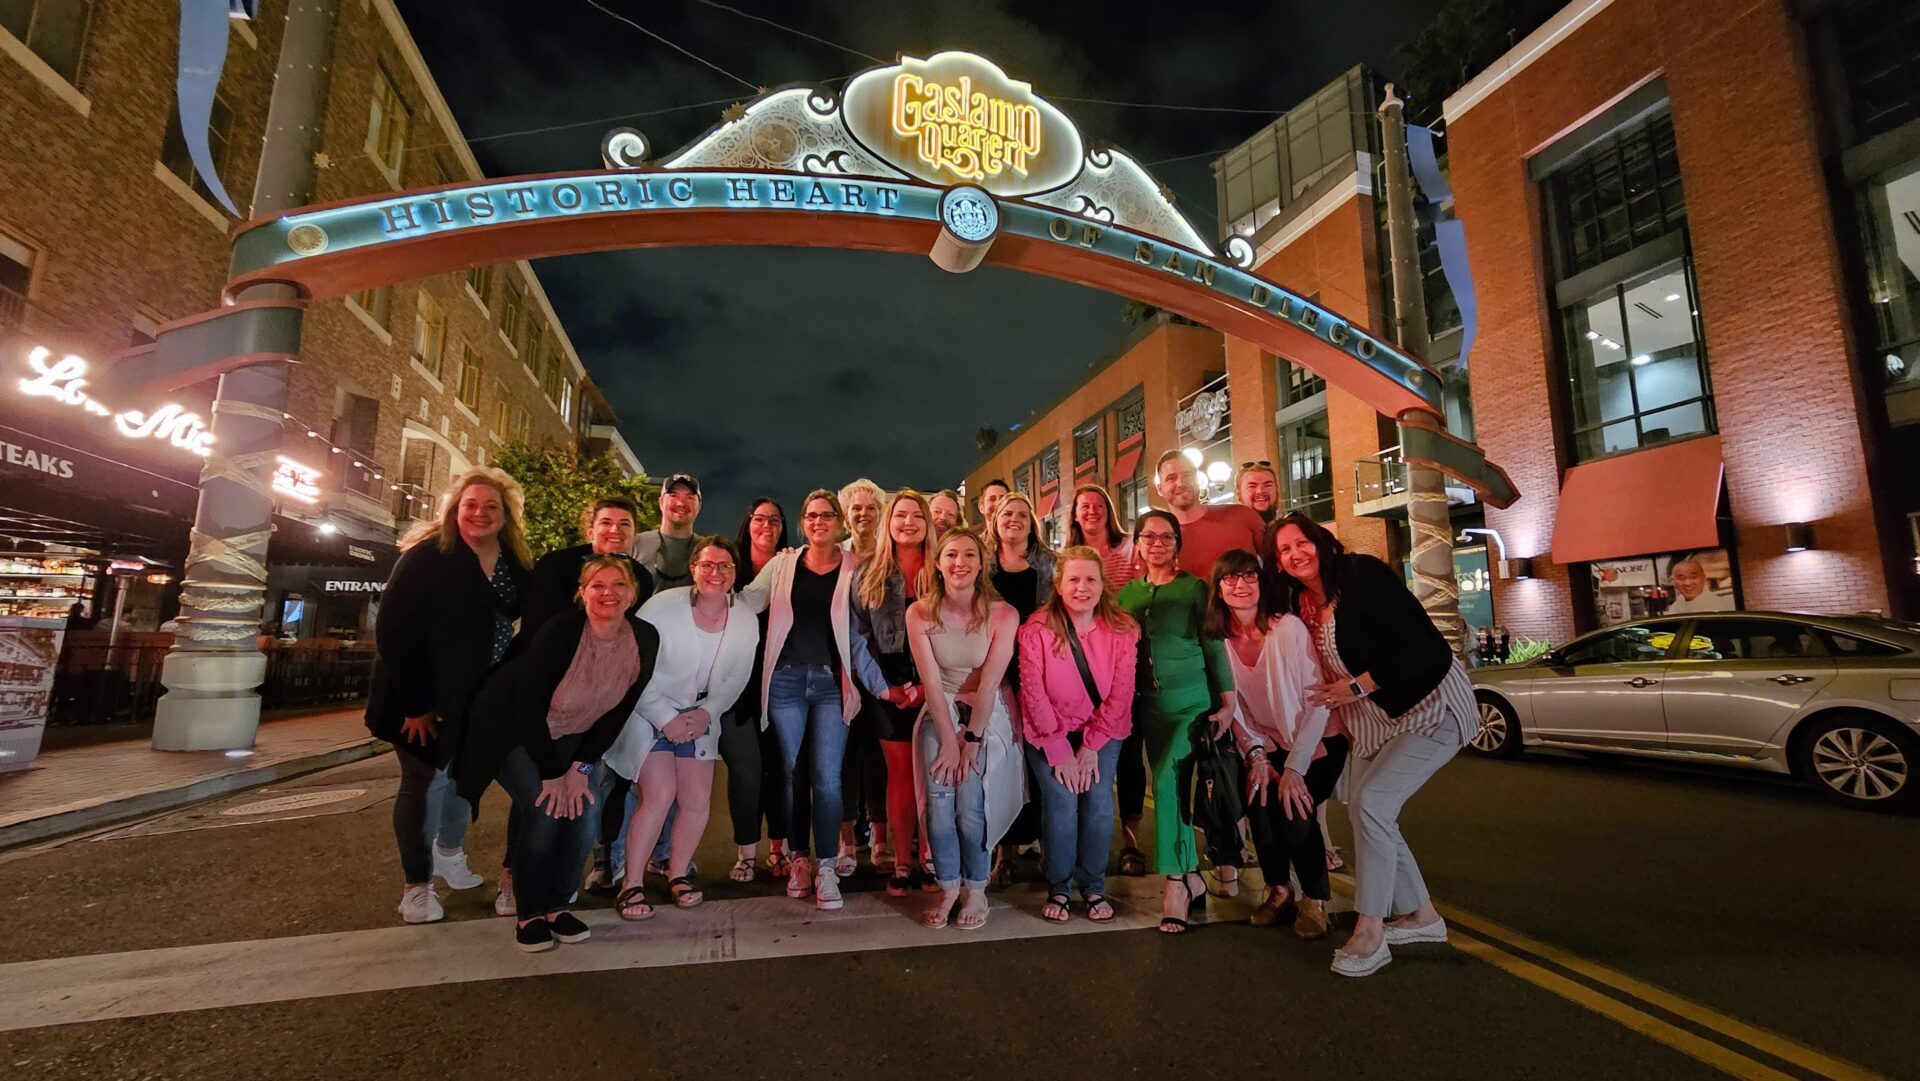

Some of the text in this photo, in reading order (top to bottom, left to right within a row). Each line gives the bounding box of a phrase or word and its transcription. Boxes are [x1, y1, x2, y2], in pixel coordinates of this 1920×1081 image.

[893, 73, 1040, 176] Gaslamp
[918, 121, 1018, 179] Quarter
[379, 177, 1377, 360] HISTORIC HEART OF SAN DIEGO
[0, 440, 75, 479] TEAKS
[325, 580, 389, 593] ENTRAN
